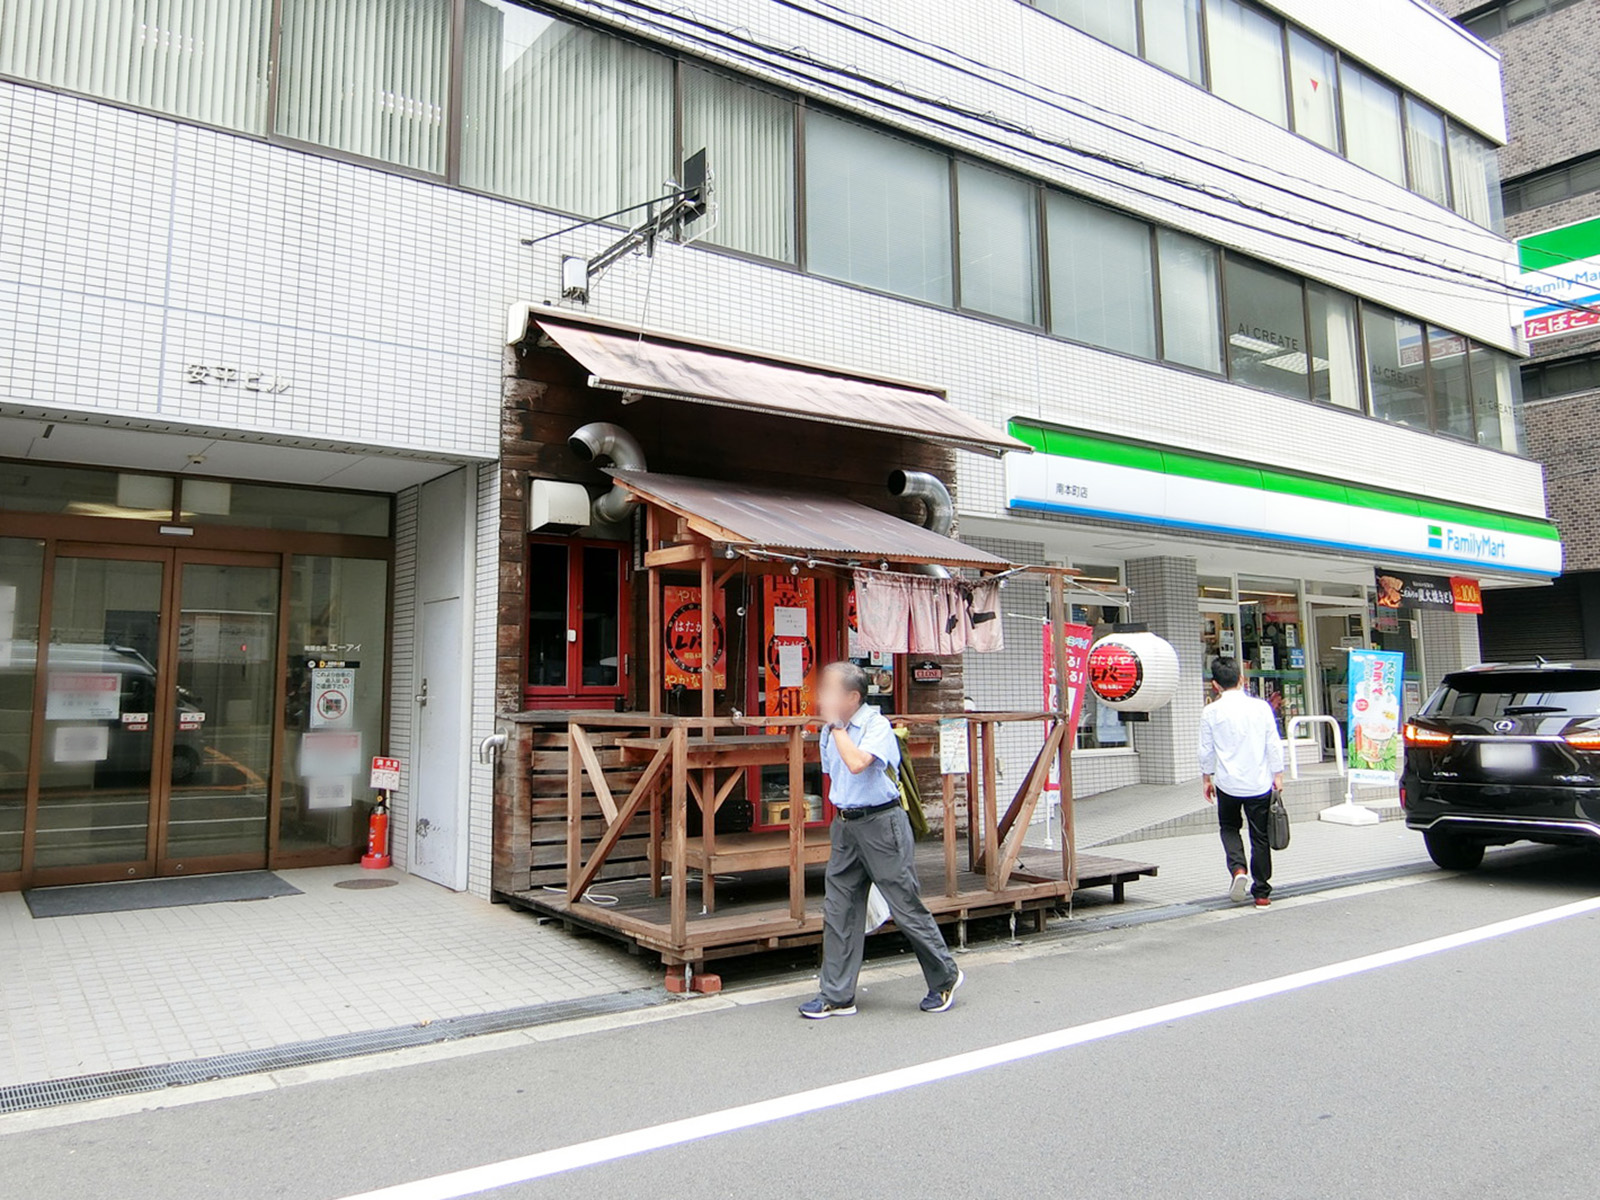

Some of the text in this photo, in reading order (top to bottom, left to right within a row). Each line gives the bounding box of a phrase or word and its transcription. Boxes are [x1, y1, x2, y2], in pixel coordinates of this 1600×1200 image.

[1527, 305, 1600, 337] たばこ・
[1238, 323, 1299, 351] AI CREATE
[187, 364, 291, 393] 安平ビル
[1383, 368, 1420, 388] CREATE
[1056, 483, 1088, 498] 南本町店
[1447, 529, 1505, 558] FamilyMart
[329, 643, 362, 652] エーアイ
[1090, 655, 1134, 665] はたがや
[665, 674, 725, 688] やかなで
[1091, 665, 1133, 682] レバー
